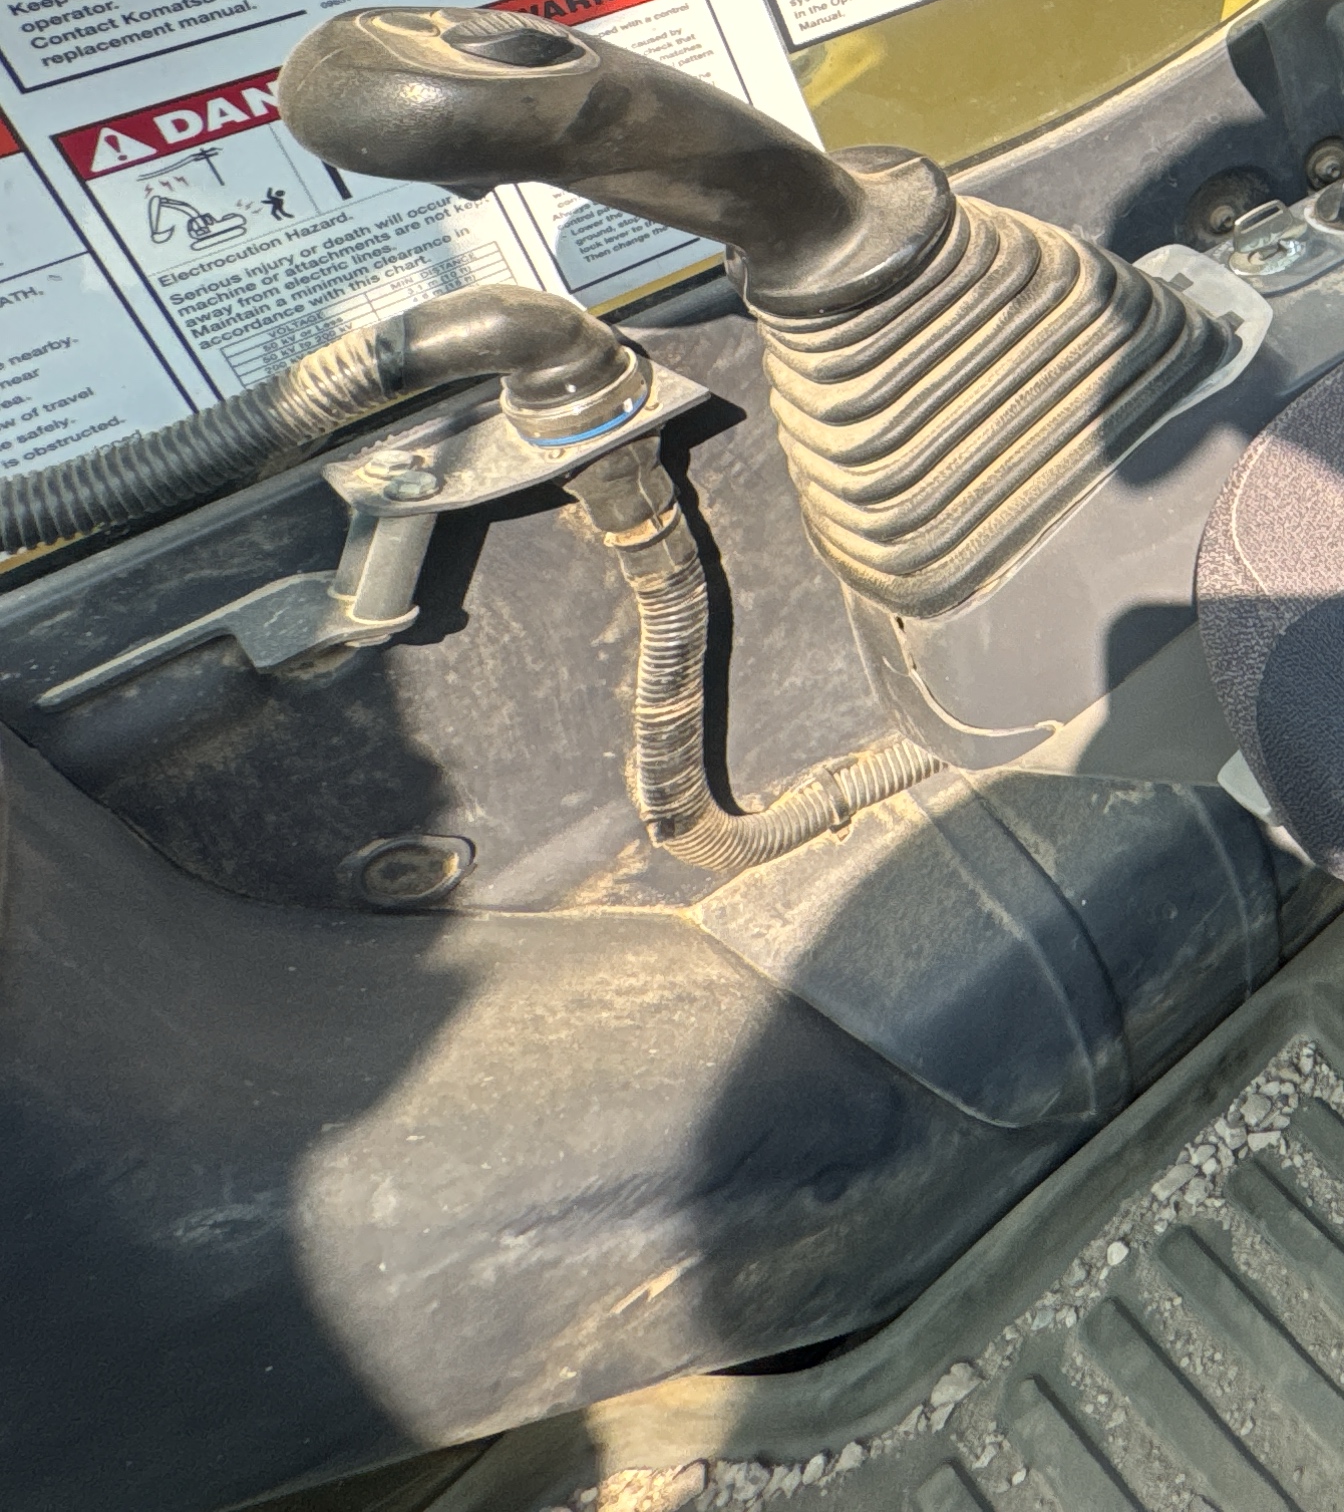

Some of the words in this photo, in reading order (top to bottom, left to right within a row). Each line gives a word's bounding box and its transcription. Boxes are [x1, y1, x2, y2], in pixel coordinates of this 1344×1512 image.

[20, 0, 119, 32] operator.
[30, 18, 119, 49] Contact
[40, 21, 175, 66] replacement
[177, 0, 257, 28] manual.
[153, 79, 280, 144] DAN
[157, 238, 282, 287] Electrocution
[284, 211, 353, 241] Hazard.
[169, 274, 242, 305] Serious
[244, 254, 294, 277] injury
[299, 245, 317, 257] or
[322, 226, 371, 249] death
[374, 212, 403, 229] will
[406, 195, 451, 218] occur
[8, 336, 78, 365] nearby.
[21, 407, 39, 422] of
[42, 387, 94, 413] travel
[17, 418, 76, 444] safely.
[23, 416, 126, 460] obstructed.
